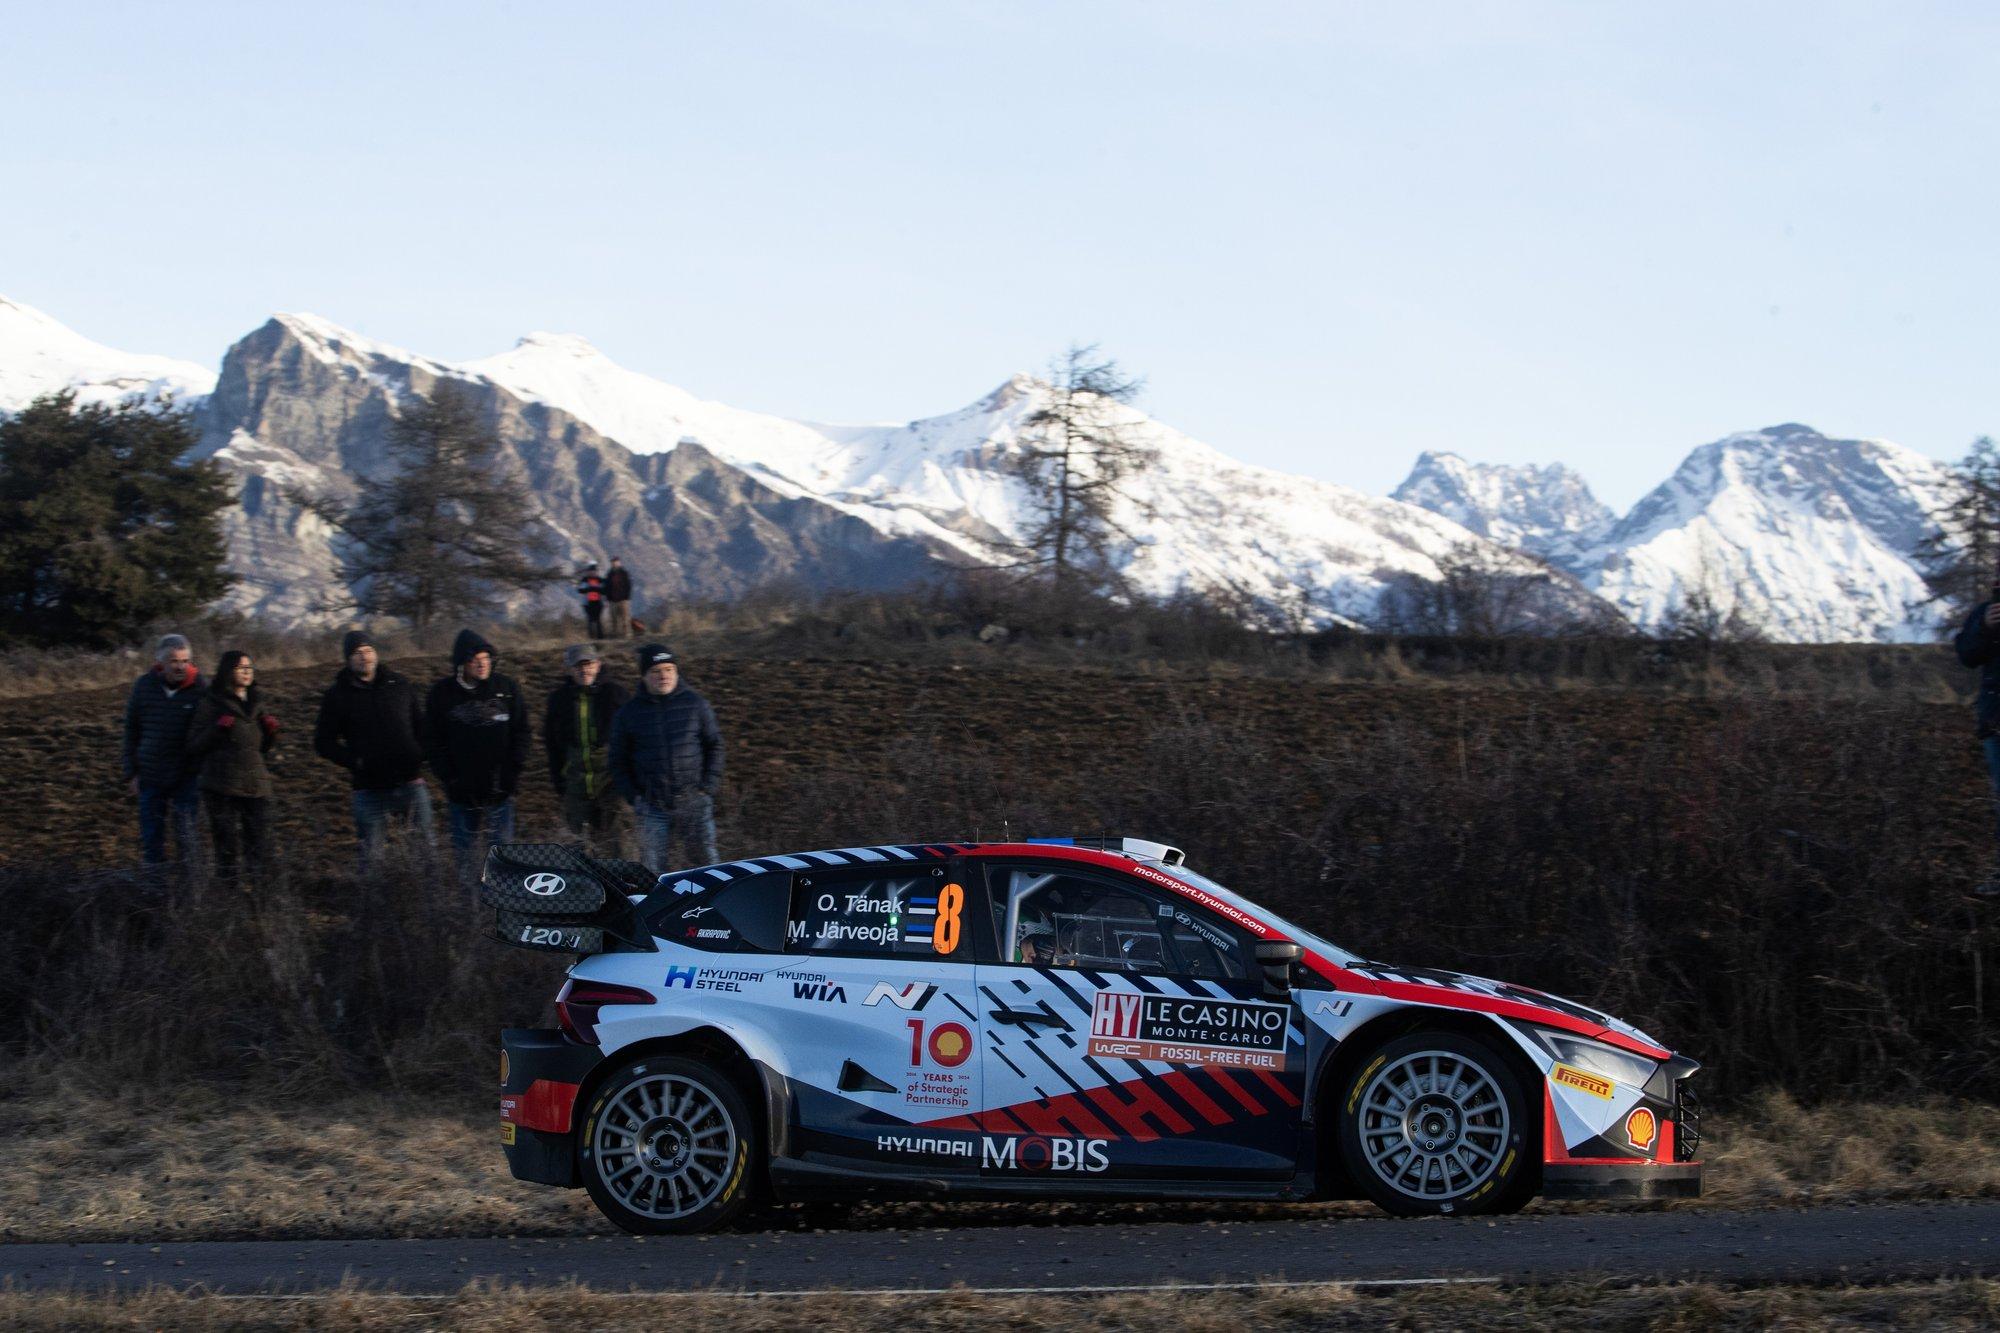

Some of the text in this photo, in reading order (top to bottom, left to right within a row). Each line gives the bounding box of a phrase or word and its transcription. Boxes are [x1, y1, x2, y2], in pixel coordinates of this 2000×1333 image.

[817, 893, 904, 914] O. Tänak
[1134, 866, 1267, 934] motorsport.hyundai.com
[932, 883, 964, 955] 8
[787, 920, 899, 945] M. Järveoja
[1191, 922, 1230, 952] HYUNDAI
[696, 980, 742, 993] STEEL
[698, 968, 764, 983] HYUNDAI
[776, 971, 826, 982] HYUNDAI
[1146, 1001, 1282, 1031] LE CASINO
[1095, 1042, 1276, 1068] WRC FOSSIL-FREE FUEL
[907, 1082, 968, 1097] of Strategic
[923, 1073, 953, 1083] YEARS
[1556, 1067, 1609, 1096] PIRELLI
[906, 1093, 969, 1107] Partnership
[877, 1135, 1109, 1173] HYUNDAI MOBIS
